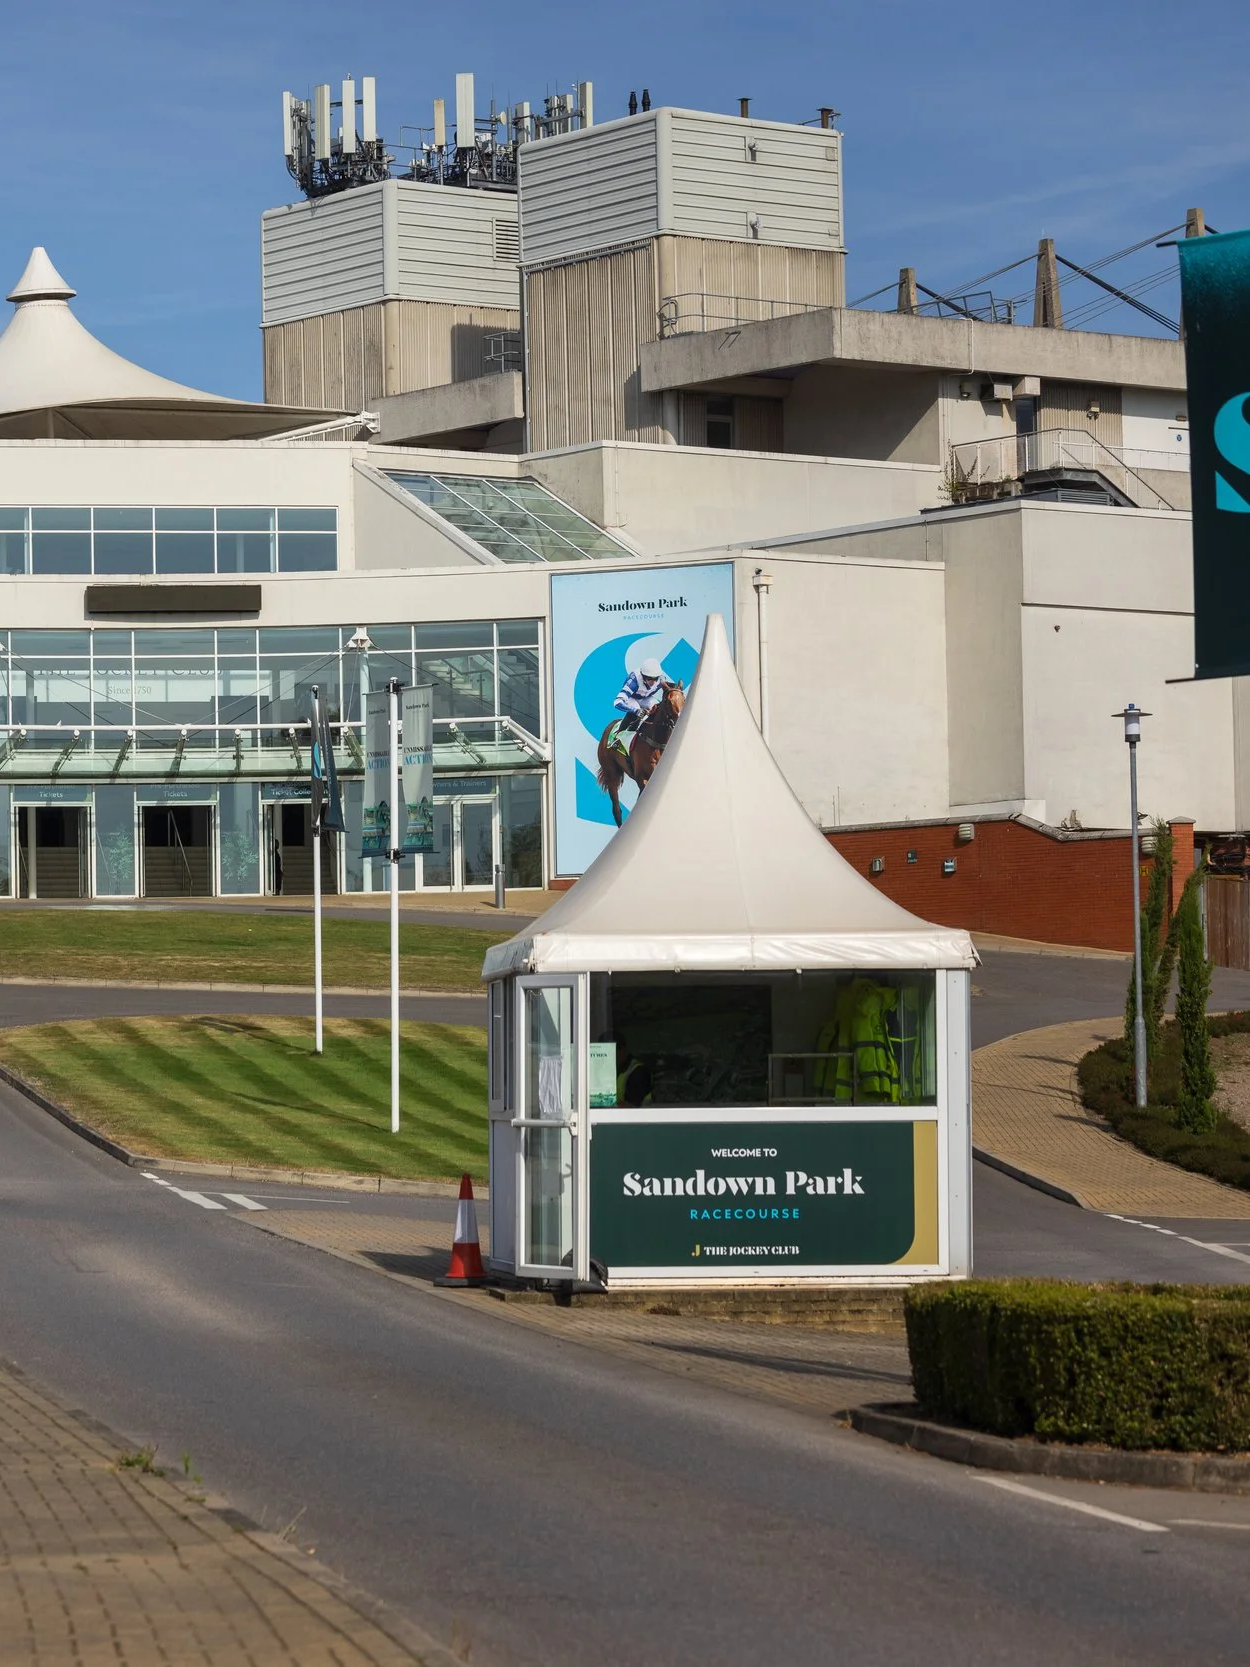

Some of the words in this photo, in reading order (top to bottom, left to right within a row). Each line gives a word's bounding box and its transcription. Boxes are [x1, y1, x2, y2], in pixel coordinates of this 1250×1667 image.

[598, 600, 655, 612] Sandown
[658, 596, 688, 608] Park
[108, 686, 131, 695] Since
[404, 752, 433, 765] ACTION
[711, 1148, 762, 1158] WELCOME
[763, 1148, 777, 1158] TO
[623, 1169, 776, 1196] Sandown
[785, 1168, 865, 1195] Park
[690, 1208, 800, 1220] RACECOURSE
[704, 1245, 727, 1256] THE
[729, 1245, 771, 1256] JOCKEY
[771, 1245, 800, 1255] CLUB
